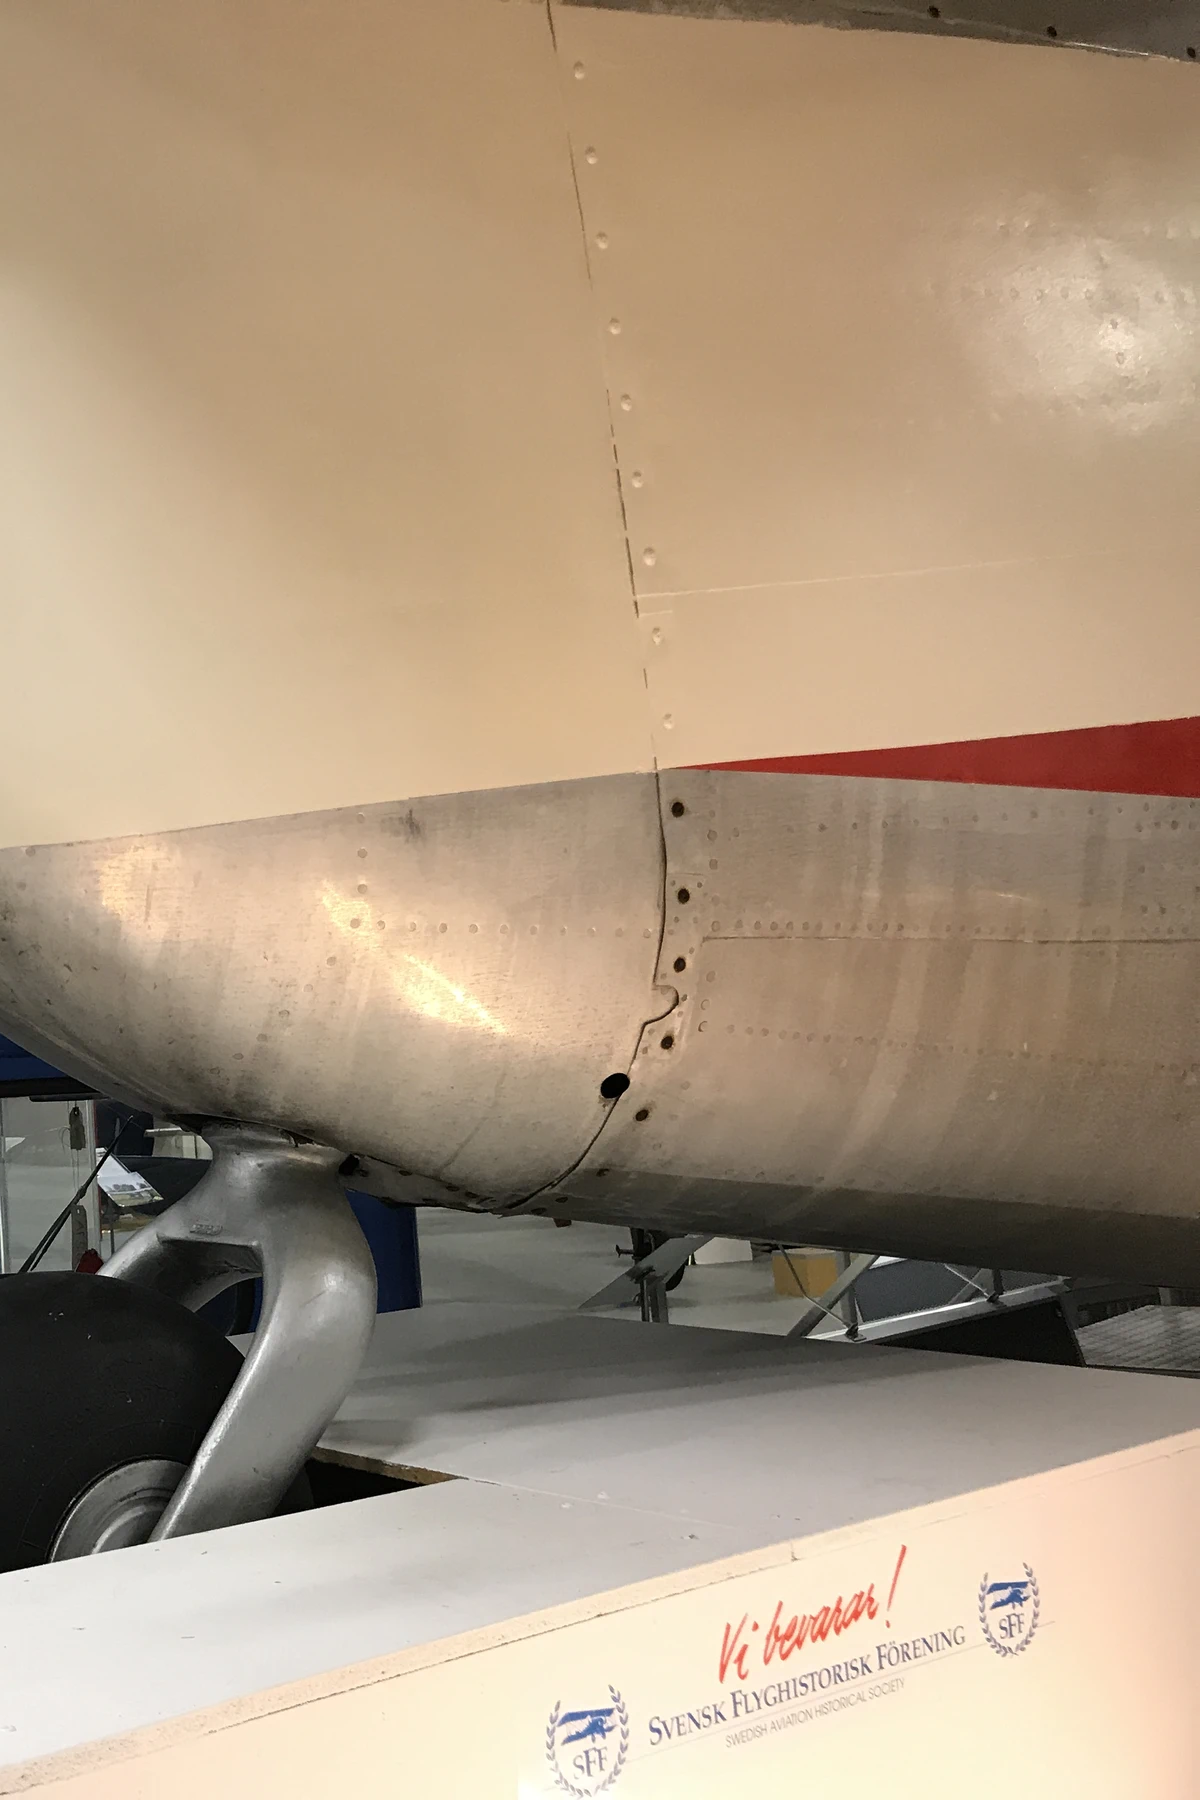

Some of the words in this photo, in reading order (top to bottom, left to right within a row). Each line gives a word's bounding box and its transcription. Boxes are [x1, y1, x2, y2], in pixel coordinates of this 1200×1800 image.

[719, 1612, 759, 1684] Vi
[998, 1612, 1025, 1640] SFF
[648, 1701, 728, 1746] SVENSK
[729, 1653, 873, 1719] FLYGHISTORISK
[875, 1625, 966, 1671] FÖRENING
[725, 1722, 768, 1748] SWEDISH
[769, 1707, 814, 1732] AVIATION
[814, 1688, 868, 1717] HISTORICAL
[868, 1677, 905, 1700] SOCIETY
[572, 1746, 608, 1780] SFF
